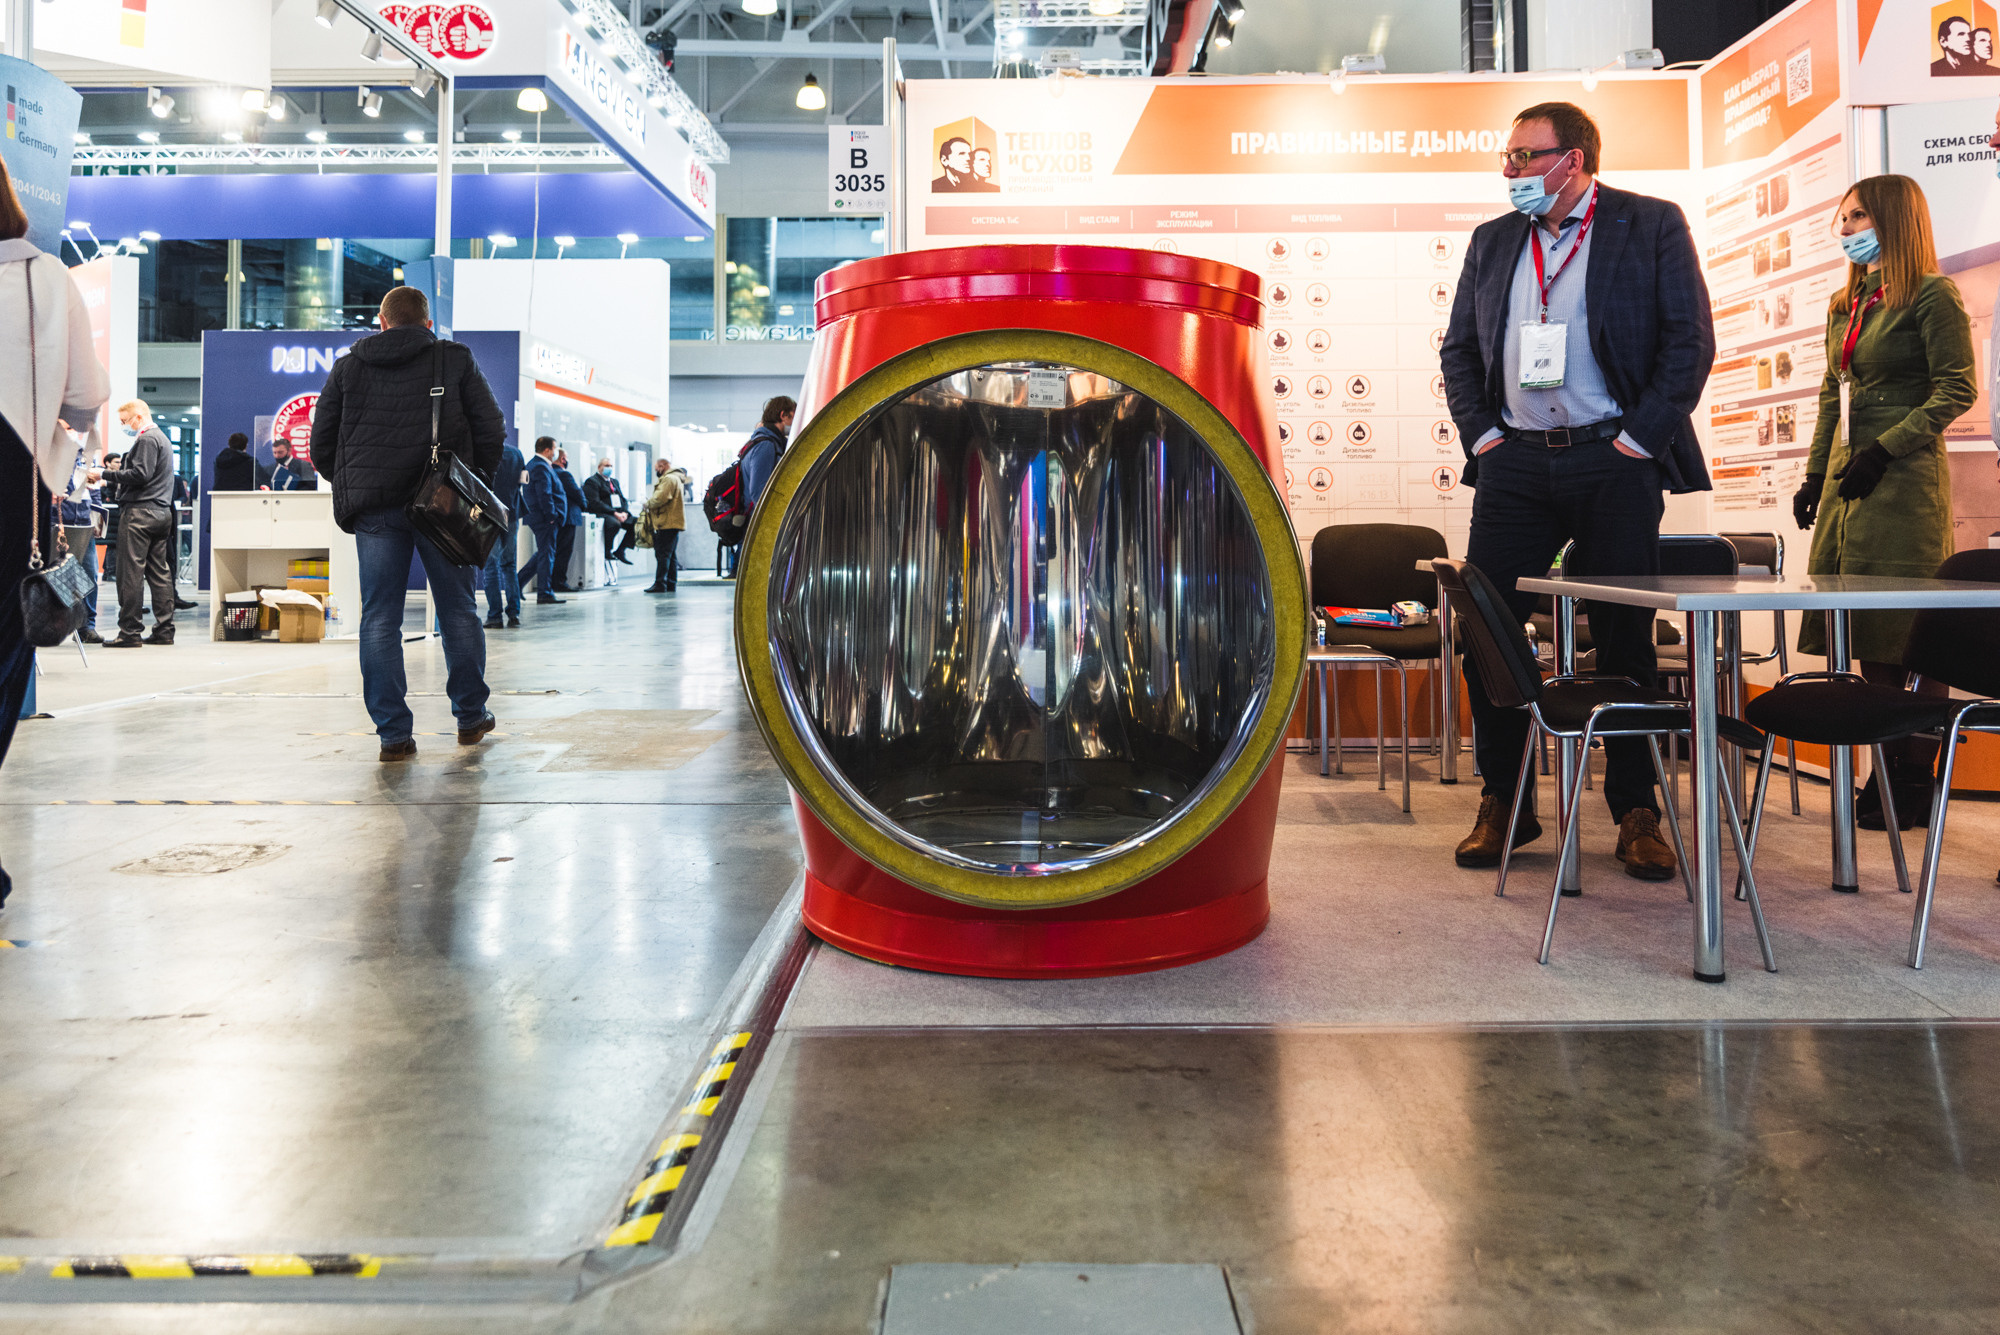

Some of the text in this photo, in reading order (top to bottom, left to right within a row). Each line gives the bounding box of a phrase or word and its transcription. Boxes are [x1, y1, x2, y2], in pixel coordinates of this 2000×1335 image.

[464, 5, 490, 26] МАРКА
[1724, 60, 1780, 105] КАК ВЫБРАТЬ
[19, 97, 44, 116] made
[1724, 76, 1781, 124] ПРАВИЛЬНЫЙ
[18, 112, 27, 127] in
[18, 131, 58, 158] Germany
[1005, 131, 1092, 151] ТЕПЛОВ
[1231, 131, 1407, 155] ПРАВИЛЬНЫЕ
[1924, 134, 1992, 149] СХЕМА СБО
[851, 148, 868, 169] B
[1021, 154, 1092, 174] СУХОВ
[1926, 153, 1953, 167] ДЛЯ
[835, 174, 885, 192] 3035
[971, 215, 1006, 225] СИСТЕМА
[1079, 215, 1120, 225] ВИД СТАЛИ
[1170, 210, 1199, 219] РЕЖИМ
[1291, 214, 1307, 224] ВИД
[1342, 446, 1377, 454] Дизельное
[1436, 448, 1452, 456] Печь
[1316, 494, 1327, 502] Газ
[1437, 494, 1453, 502] Печь
